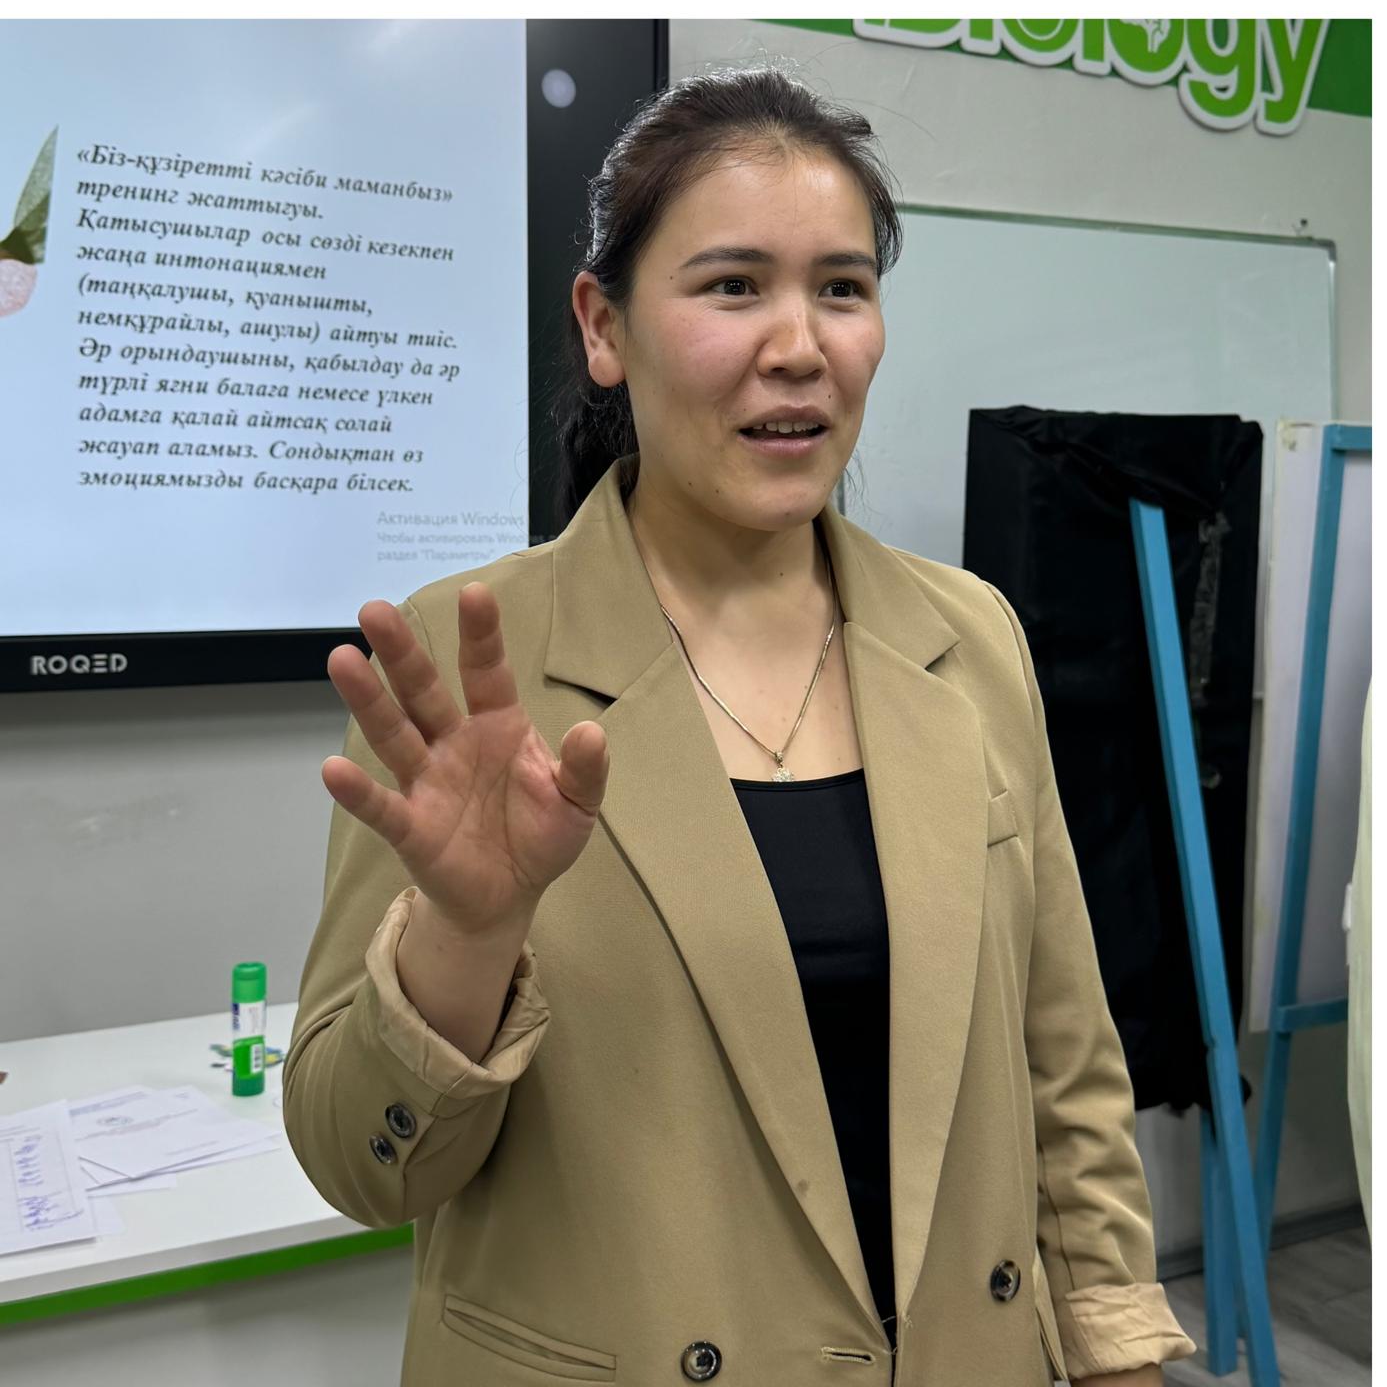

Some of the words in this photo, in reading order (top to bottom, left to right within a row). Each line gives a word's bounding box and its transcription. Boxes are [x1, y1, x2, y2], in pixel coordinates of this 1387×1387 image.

[76, 179, 180, 203] тренинг
[260, 167, 328, 189] кәсіби
[333, 178, 454, 203] маманбыз»
[76, 207, 251, 247] Қатысушылар
[261, 230, 302, 248] осы
[309, 233, 363, 253] сөзді
[367, 240, 455, 262] кезекпен
[76, 245, 147, 268] жаңа
[154, 251, 327, 280] интонациямен
[78, 272, 235, 306] (таңқалушы,
[245, 290, 373, 317] қуанышты,
[239, 321, 321, 345] ашулы)
[329, 324, 398, 349] айтуы
[406, 330, 458, 349] тиіс.
[78, 337, 112, 364] Әр
[120, 343, 296, 373] орындаушыны,
[304, 353, 404, 379] қабылдау
[410, 358, 433, 377] да
[438, 364, 461, 383] әр
[78, 372, 150, 396] түрлі
[297, 385, 370, 403] немесе
[376, 389, 433, 408] үлкен
[171, 408, 239, 430] қалай
[246, 410, 329, 435] айтсақ
[335, 415, 393, 434] солай
[78, 439, 161, 460] жауап
[167, 441, 259, 460] аламыз.
[268, 439, 395, 465] Сондықтан
[402, 449, 424, 464] өз
[79, 469, 244, 491] эмоциямызды
[253, 471, 339, 495] басқара
[346, 472, 414, 493] білсек.
